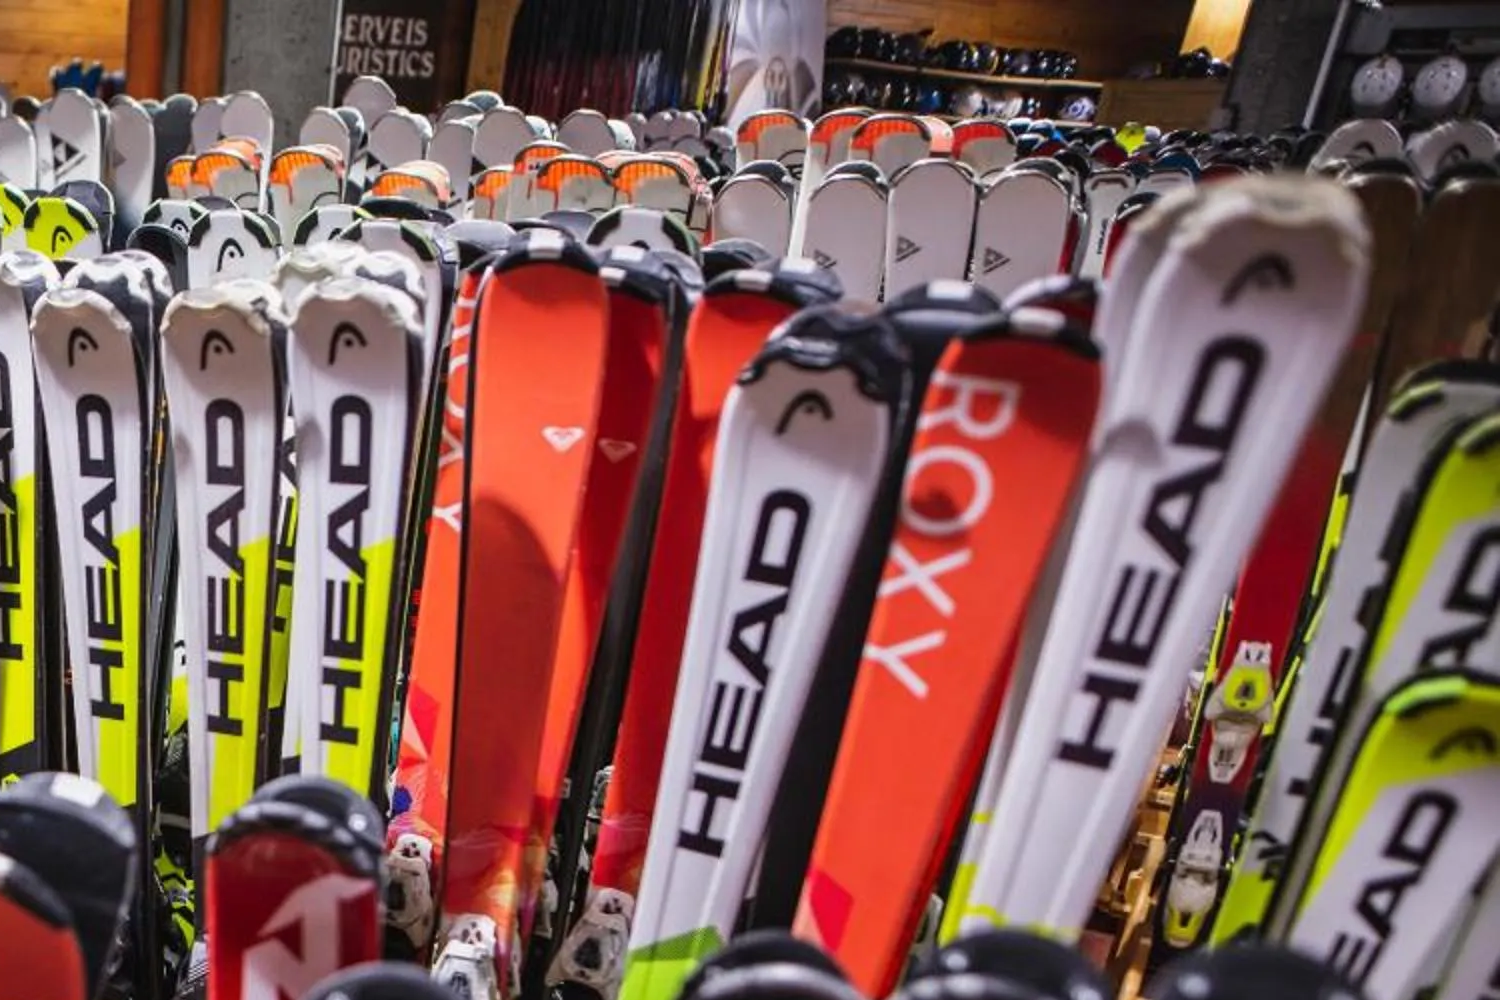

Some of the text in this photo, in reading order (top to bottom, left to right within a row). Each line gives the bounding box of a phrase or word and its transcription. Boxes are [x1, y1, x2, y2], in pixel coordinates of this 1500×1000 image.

[336, 45, 435, 78] URISTICS
[343, 14, 428, 46] ERVEIS
[76, 393, 125, 721] HEAD
[205, 398, 246, 737] HEAD
[319, 394, 372, 745] HEAD
[678, 488, 812, 859] HEAD
[863, 368, 1021, 699] ROXY
[1057, 334, 1269, 772] HEAD
[1328, 790, 1461, 985] EAD
